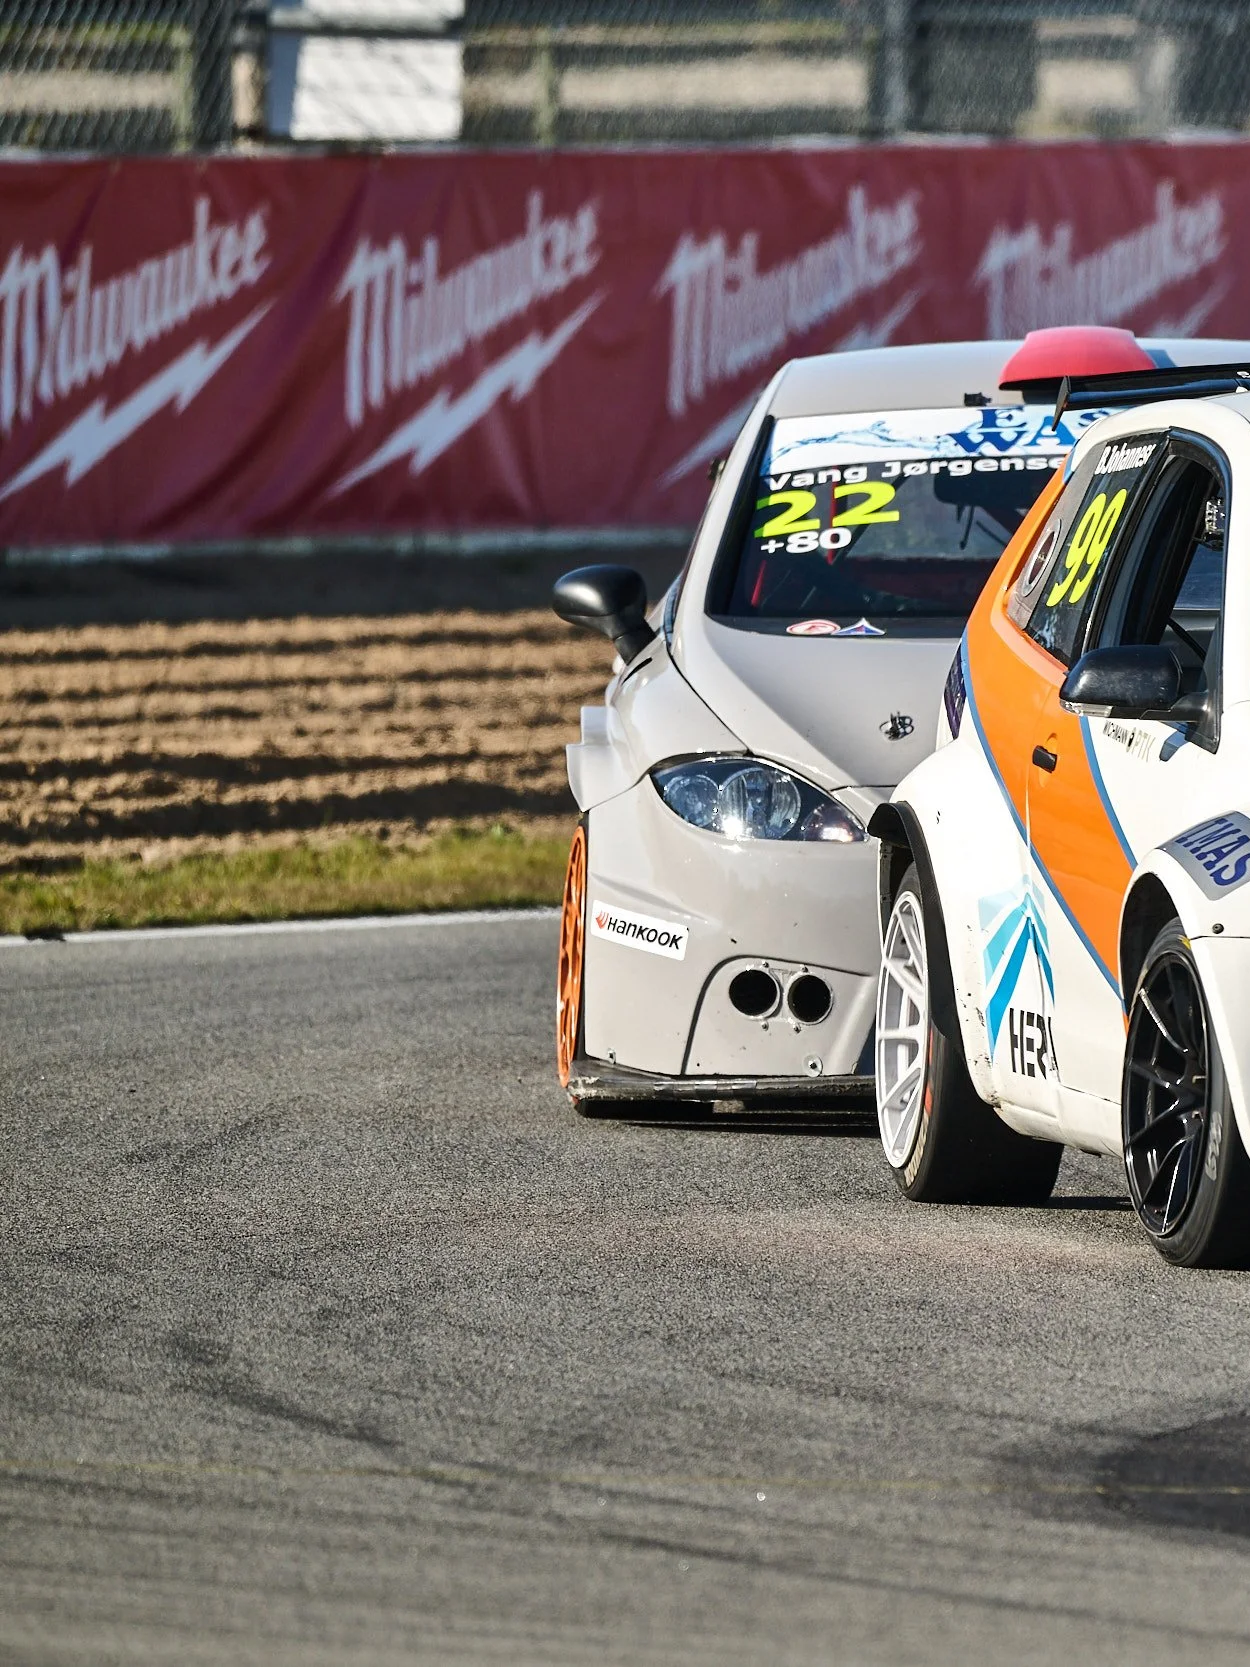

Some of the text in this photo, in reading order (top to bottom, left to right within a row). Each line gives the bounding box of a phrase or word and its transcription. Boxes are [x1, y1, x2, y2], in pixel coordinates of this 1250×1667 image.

[333, 190, 602, 430] Milwaukee
[769, 466, 868, 491] Vang
[754, 481, 900, 538] 22
[760, 527, 852, 554] +80
[1046, 489, 1127, 607] 99
